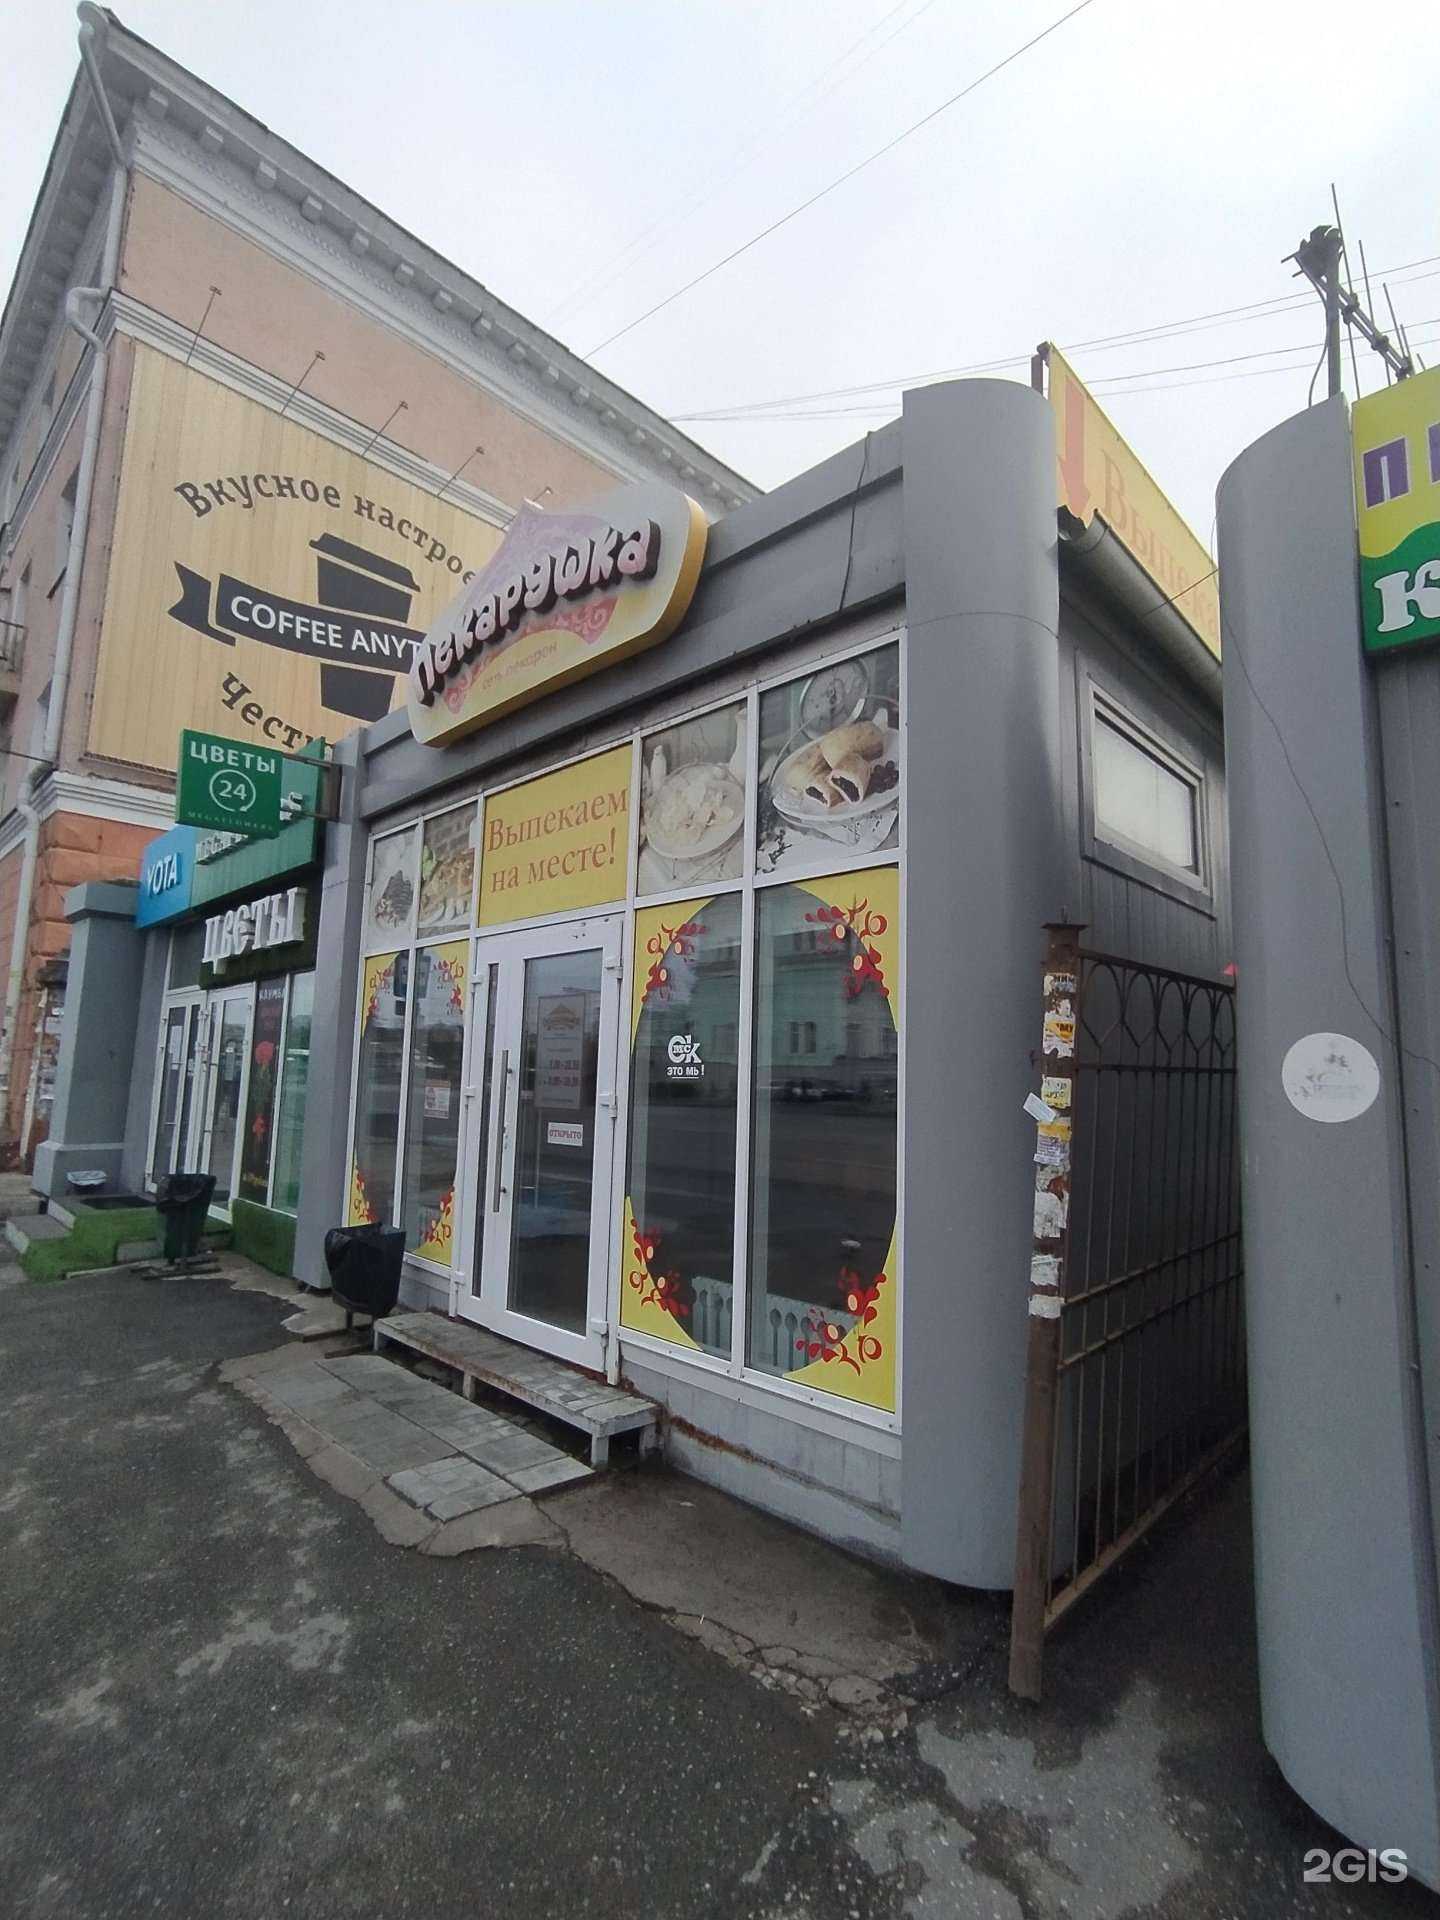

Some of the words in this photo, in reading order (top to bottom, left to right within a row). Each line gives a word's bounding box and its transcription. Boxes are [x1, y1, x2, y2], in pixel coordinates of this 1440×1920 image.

[174, 472, 341, 518] Вкусное
[230, 595, 343, 649] COFFEE
[414, 518, 661, 707] Пекарушка
[221, 671, 337, 750] Чест
[190, 741, 276, 774] ЦВЕТЫ
[219, 780, 248, 801] 24
[487, 788, 629, 852] Выпекаем
[146, 852, 177, 897] YOTA
[491, 869, 520, 893] на
[528, 827, 617, 884] месте!
[202, 887, 304, 974] ЦВЕТЫ
